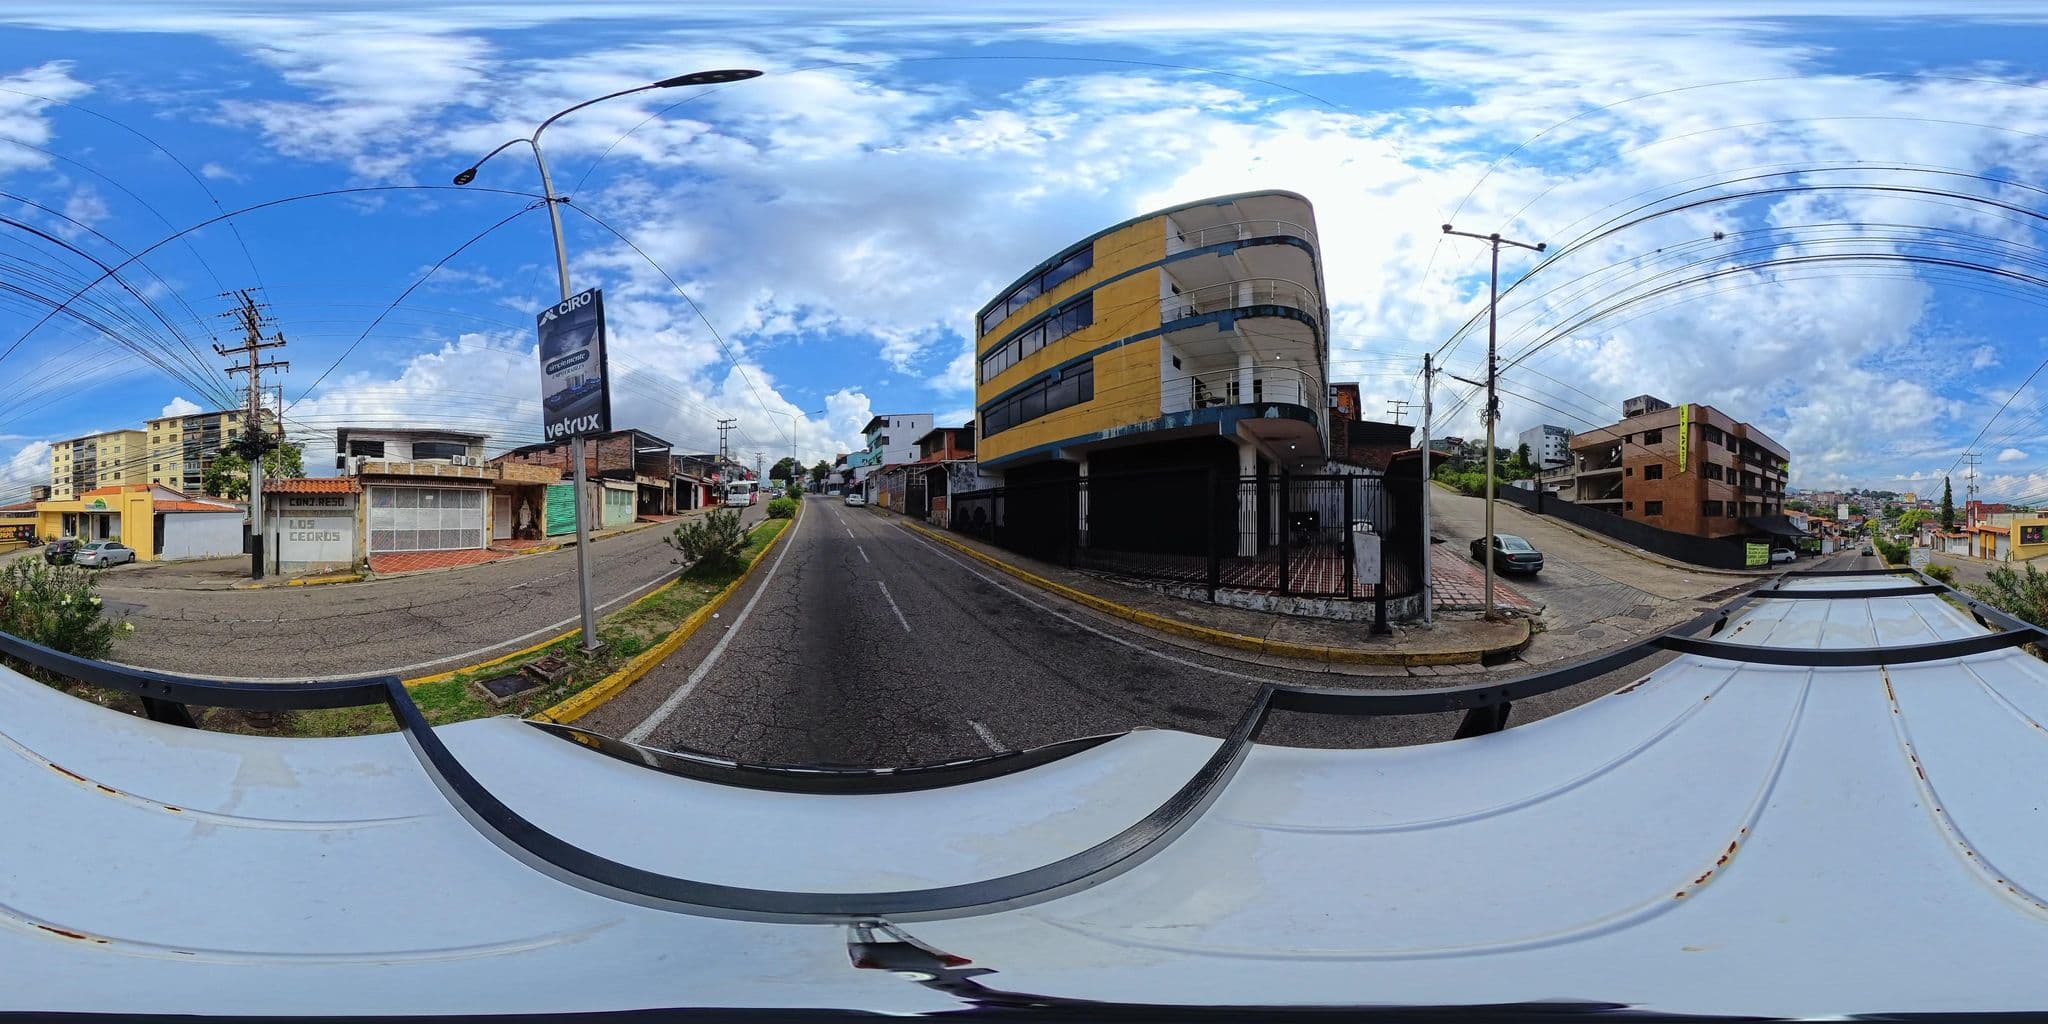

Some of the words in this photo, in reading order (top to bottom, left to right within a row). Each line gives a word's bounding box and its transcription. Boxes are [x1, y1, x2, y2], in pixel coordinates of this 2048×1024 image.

[559, 292, 591, 314] CIRO
[546, 414, 599, 438] vetrux
[290, 520, 315, 529] LOS
